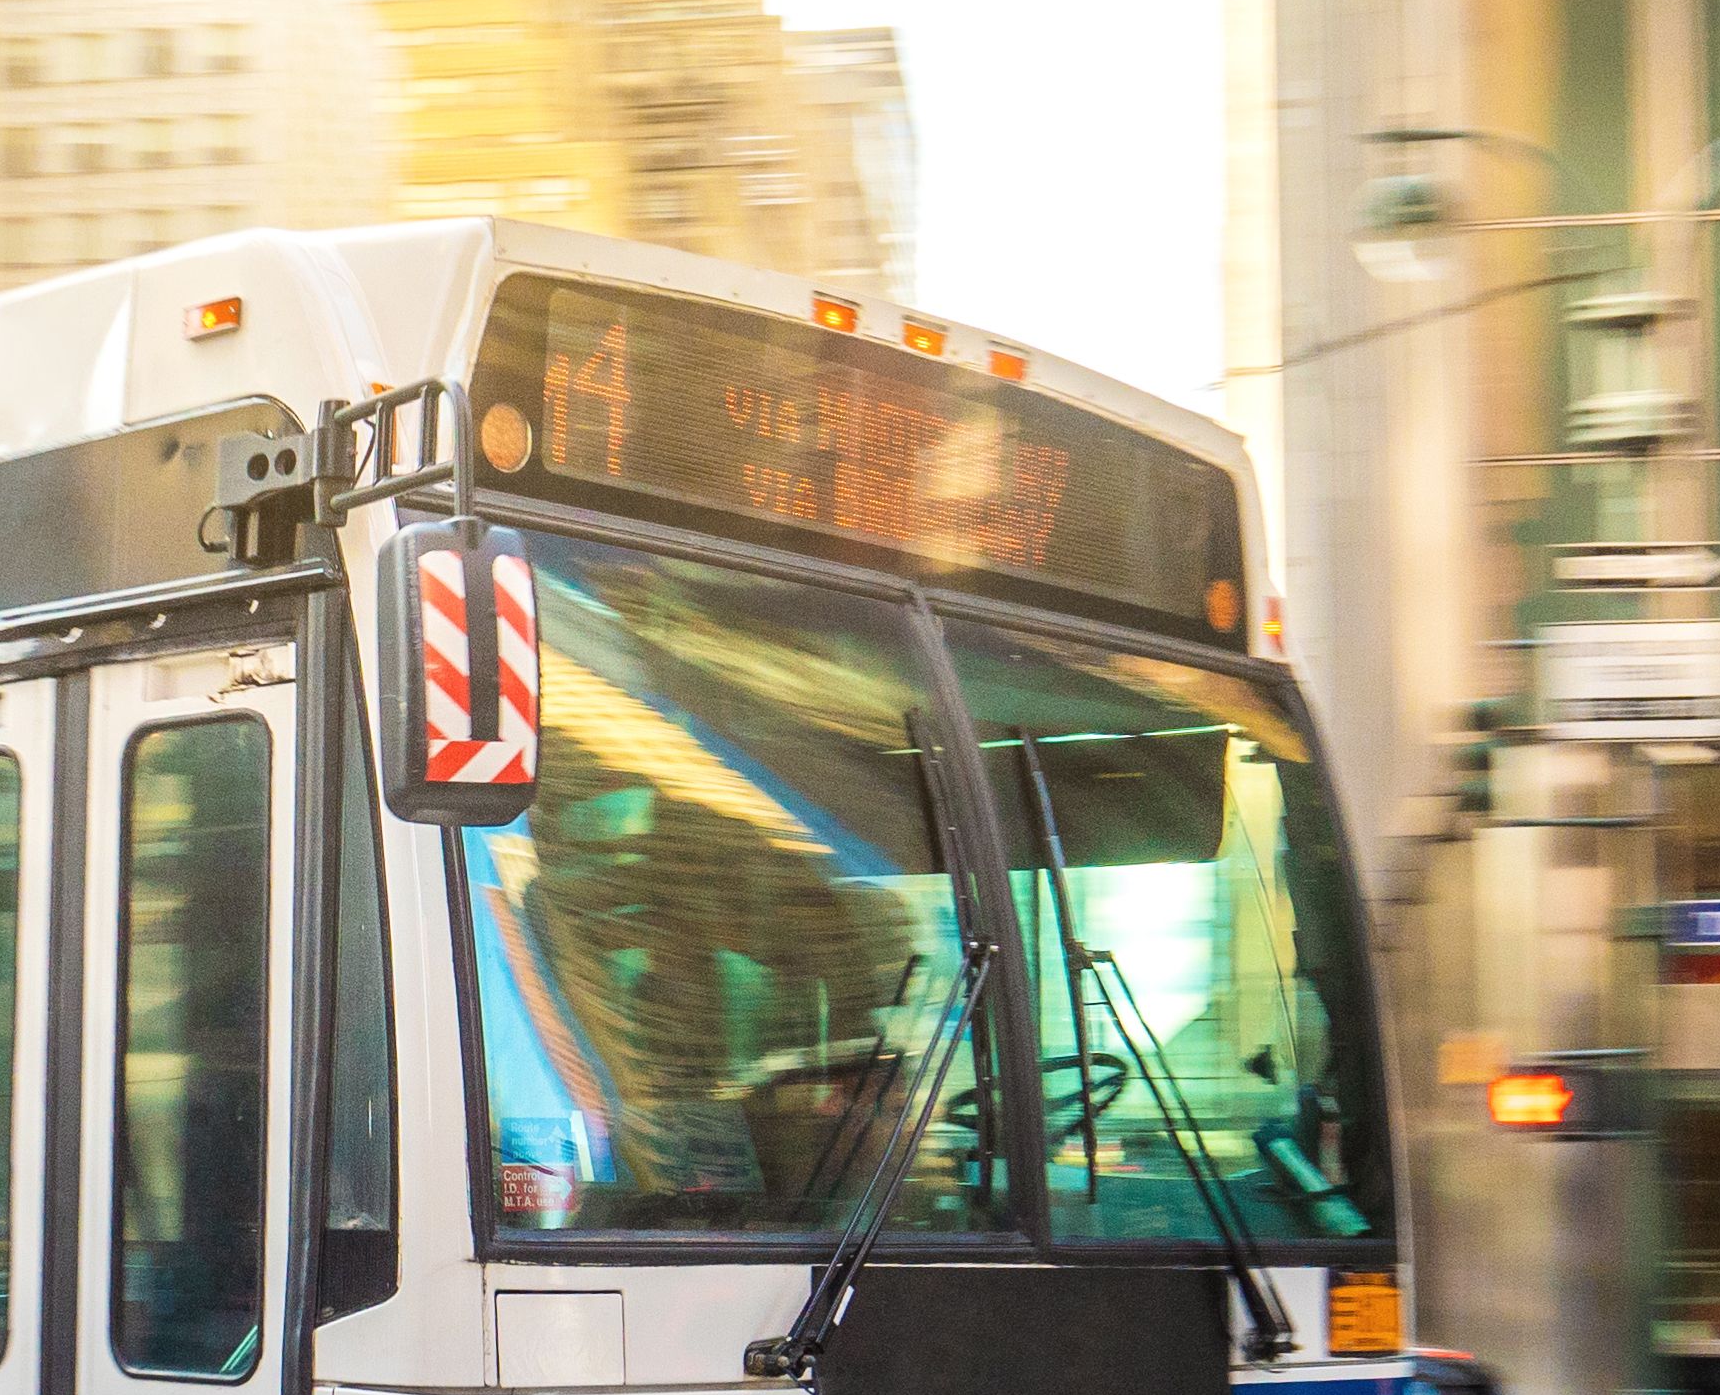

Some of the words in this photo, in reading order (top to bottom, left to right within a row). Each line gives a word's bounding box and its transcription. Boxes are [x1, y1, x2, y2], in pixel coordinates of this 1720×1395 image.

[742, 463, 818, 521] VIA
[503, 1183, 520, 1194] I.D.
[523, 1182, 538, 1194] for
